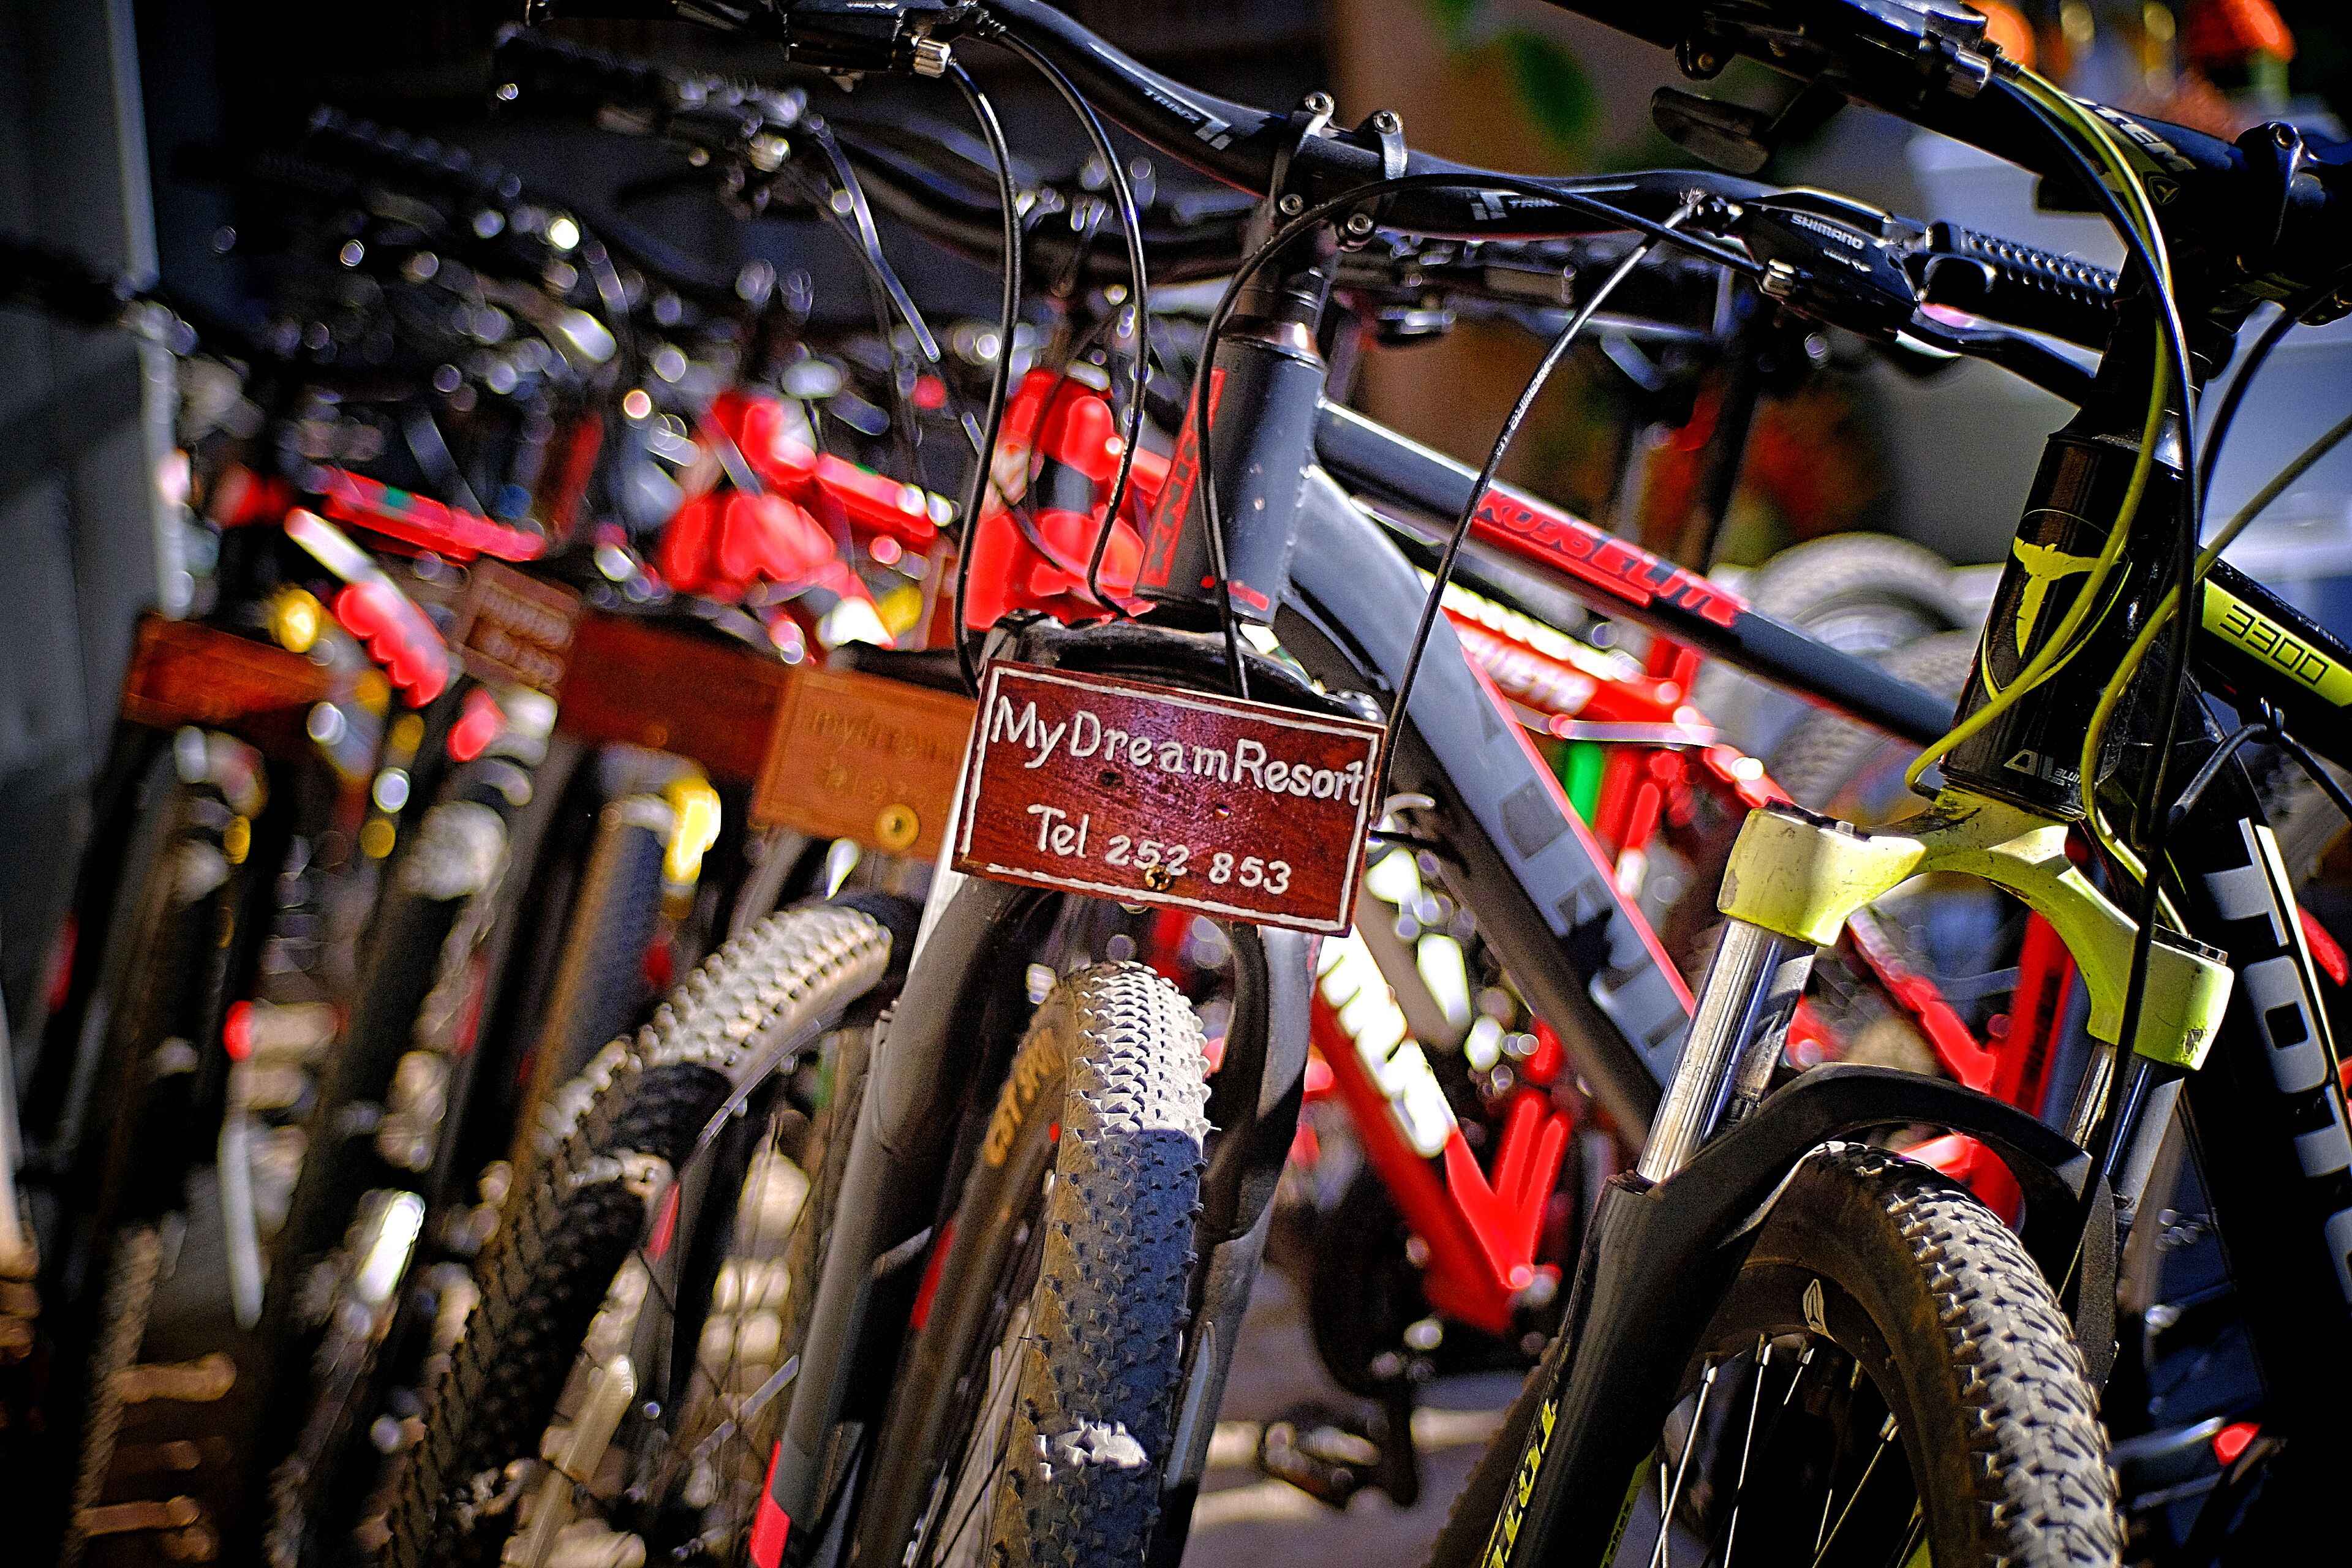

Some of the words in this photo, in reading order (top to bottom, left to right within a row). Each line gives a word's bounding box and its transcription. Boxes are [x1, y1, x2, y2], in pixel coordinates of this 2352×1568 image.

[1790, 213, 1866, 250] SHIMANO
[2218, 603, 2330, 687] 3300
[1027, 803, 1090, 859] Tel
[1104, 835, 1189, 876] 252
[1208, 852, 1292, 895] 853
